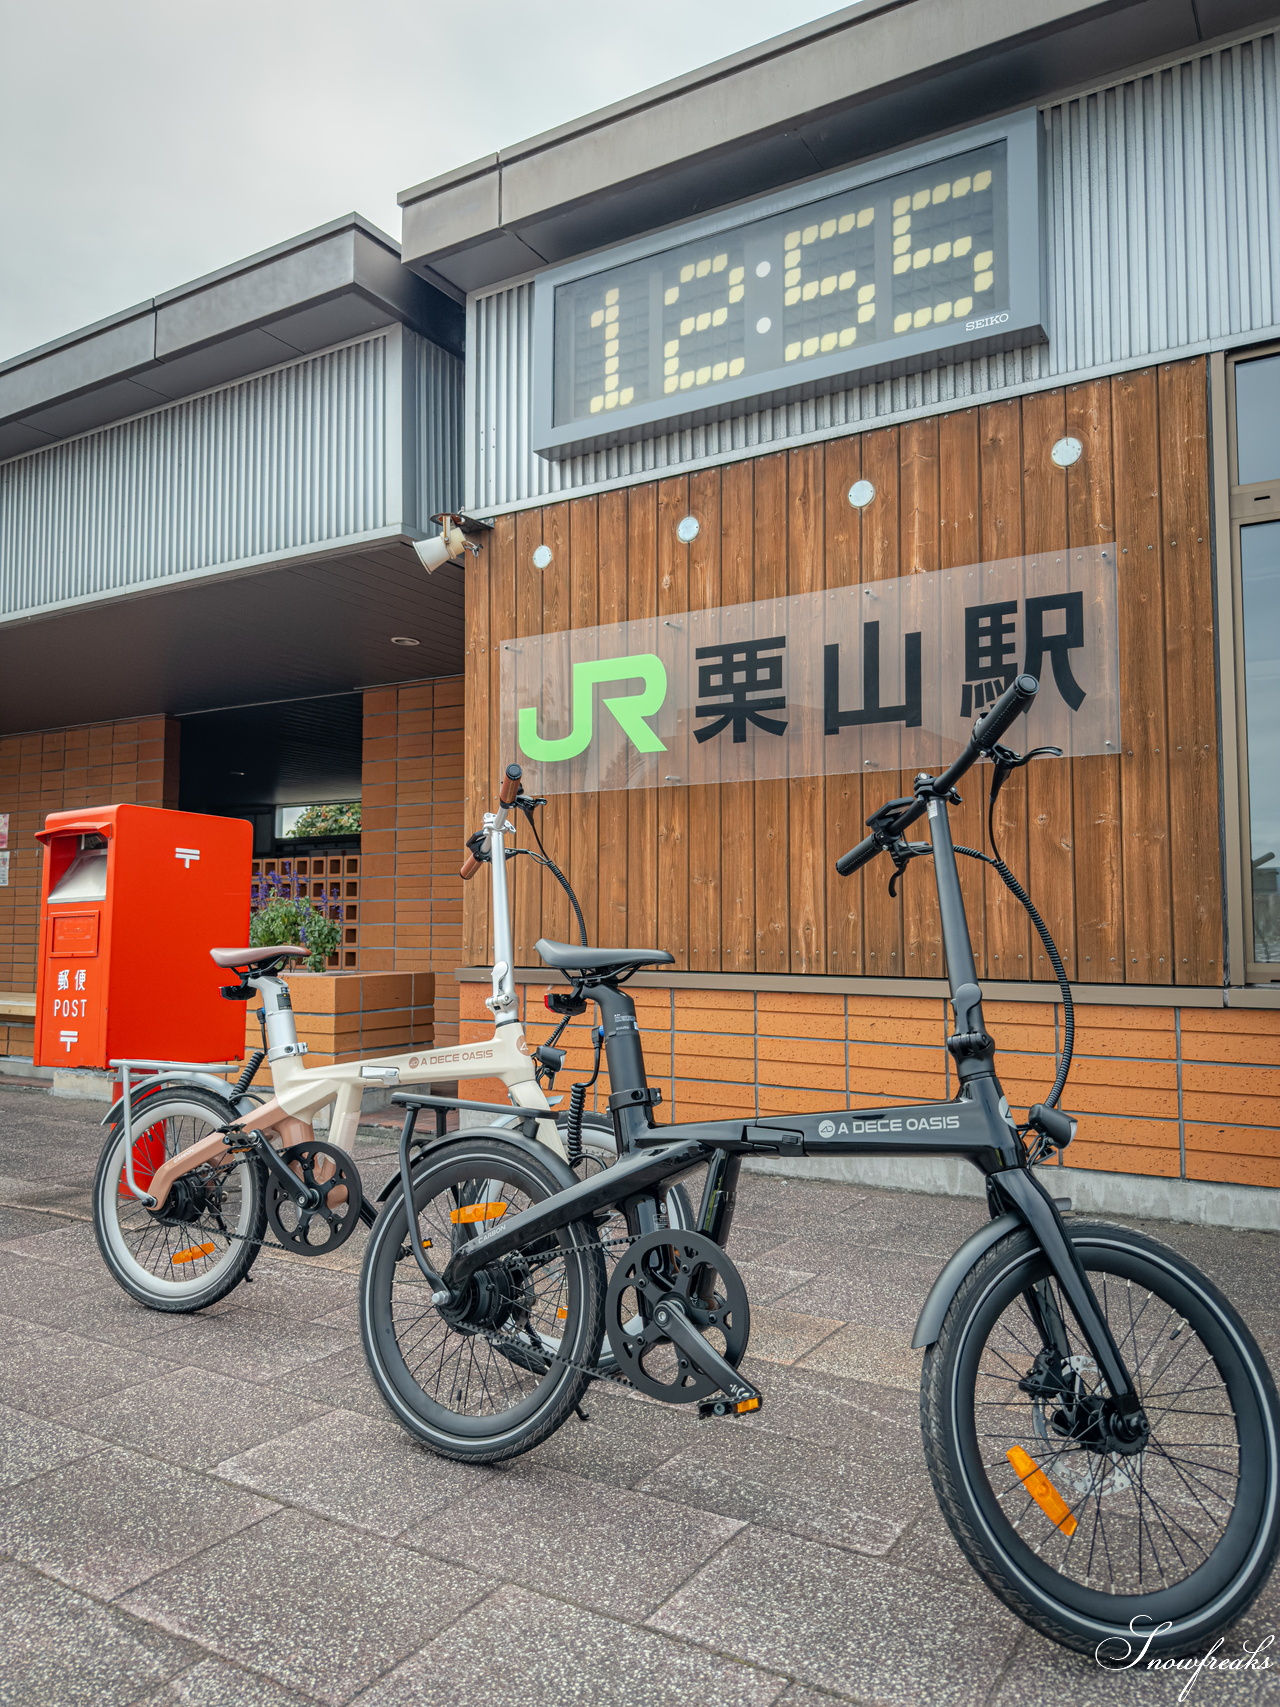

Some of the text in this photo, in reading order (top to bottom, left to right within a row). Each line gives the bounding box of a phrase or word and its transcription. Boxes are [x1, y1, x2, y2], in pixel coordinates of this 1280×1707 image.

[590, 169, 993, 414] 12:55
[965, 312, 1009, 332] SEIKO
[518, 590, 1088, 763] JR 栗山駅
[57, 969, 87, 991] 郵便
[53, 999, 88, 1018] POST
[420, 1049, 494, 1066] A DECE OASIS
[837, 1122, 849, 1135] A
[852, 1119, 902, 1134] DECE
[906, 1115, 960, 1131] OASIS
[478, 1224, 506, 1244] CARBON
